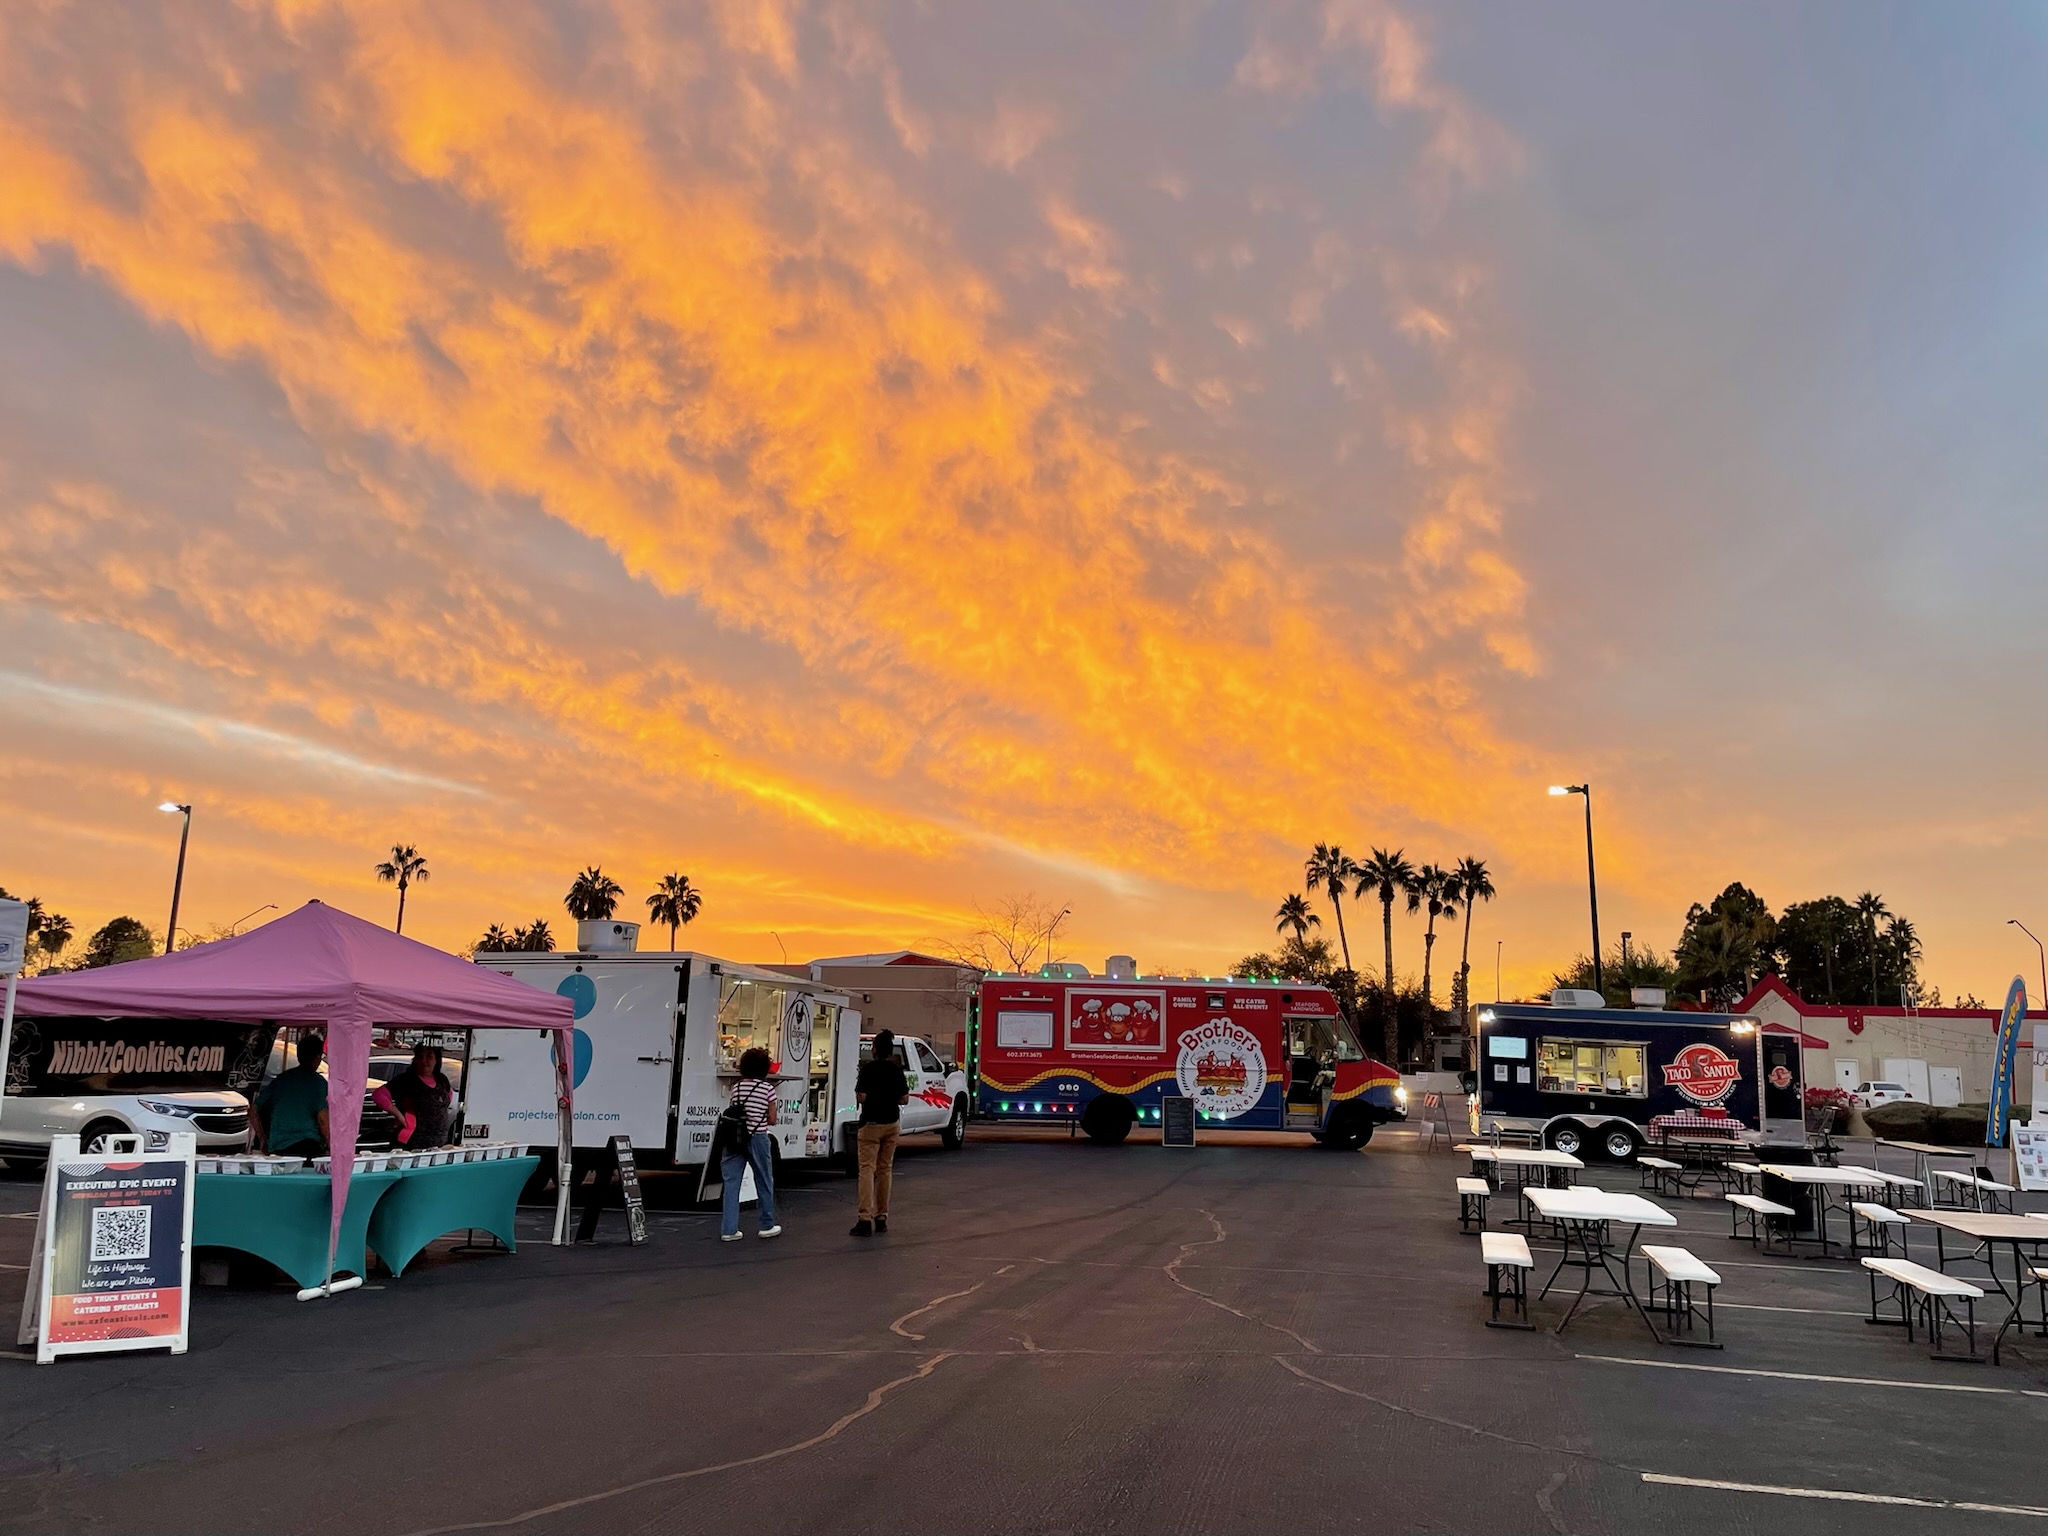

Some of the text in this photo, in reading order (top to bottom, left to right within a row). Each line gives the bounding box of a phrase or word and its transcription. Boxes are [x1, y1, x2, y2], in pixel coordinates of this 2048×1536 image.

[1182, 1021, 1257, 1052] Brothers
[1201, 1039, 1243, 1052] SEAFOOD
[47, 1040, 225, 1075] NibblzCookies.com
[1681, 1059, 1690, 1068] EL
[1667, 1065, 1735, 1081] TACO SANTO
[508, 1110, 621, 1121] projectseolon.com
[65, 1178, 178, 1191] EXECUTING EPIC EVENTS
[141, 1189, 162, 1197] TODAY
[87, 1264, 103, 1276] Life
[103, 1264, 111, 1273] is
[81, 1276, 156, 1289] We are your Pitstop
[73, 1296, 92, 1304] FOOD
[95, 1294, 119, 1303] TRUCK
[121, 1292, 150, 1301] EVENTS
[74, 1302, 159, 1315] CATERING SPECIALISTS
